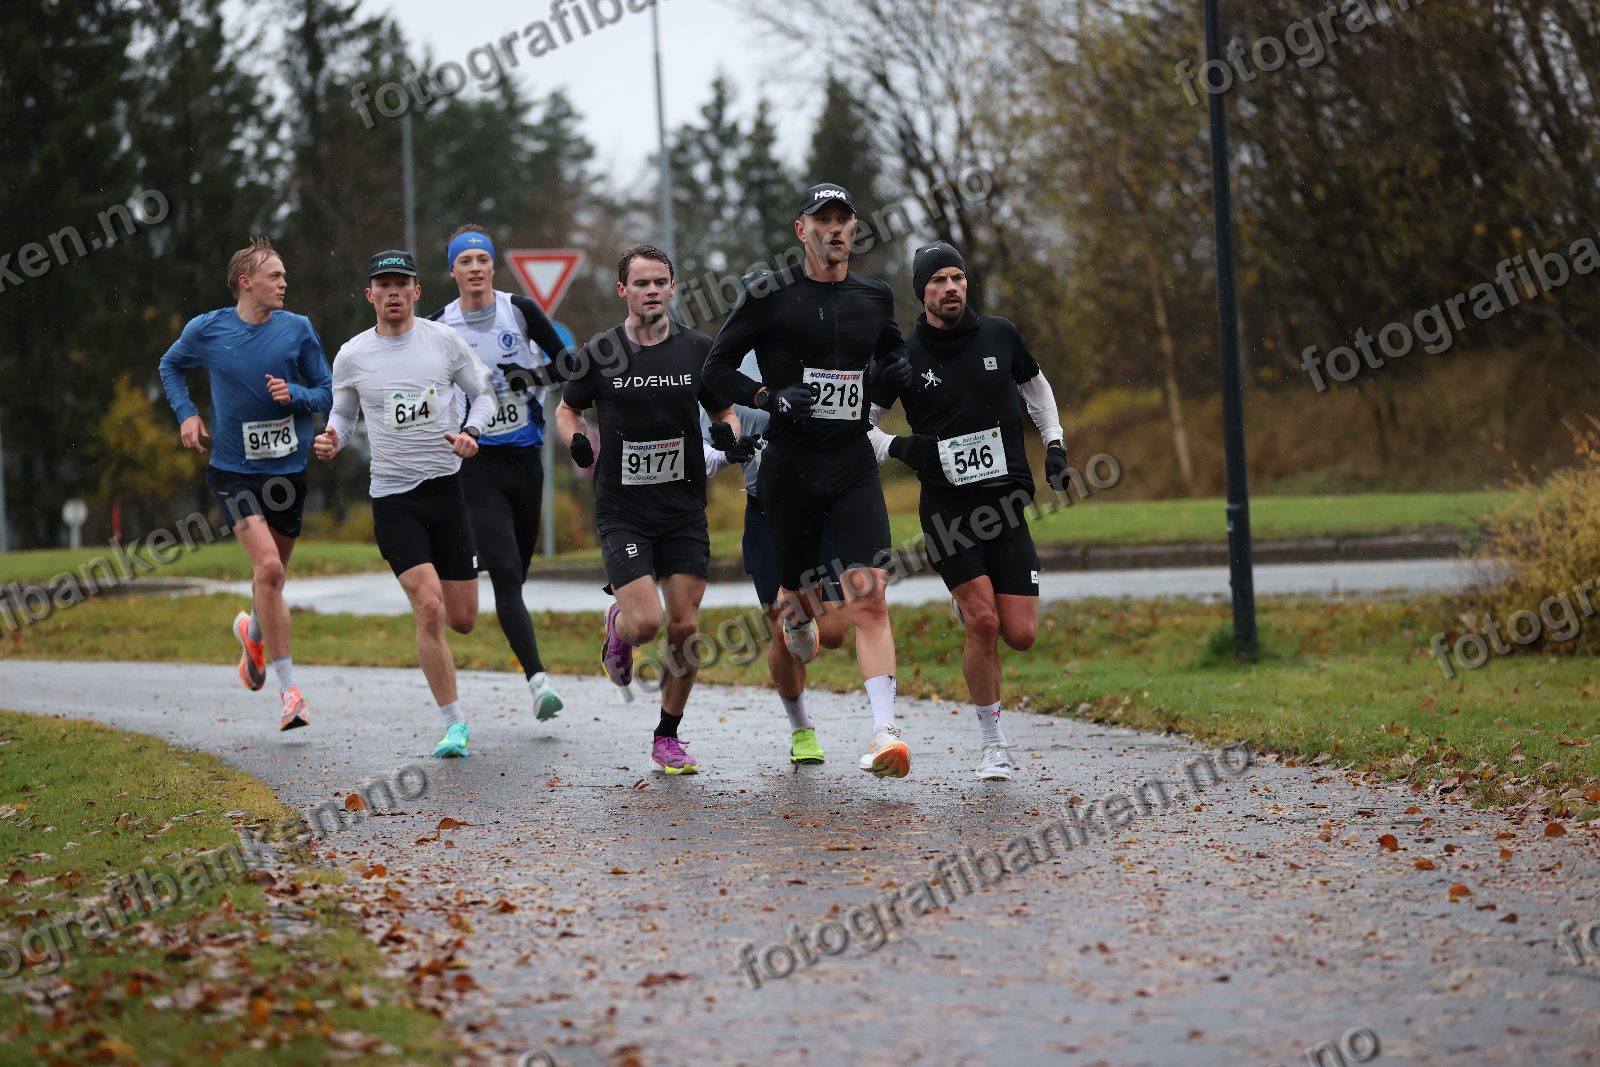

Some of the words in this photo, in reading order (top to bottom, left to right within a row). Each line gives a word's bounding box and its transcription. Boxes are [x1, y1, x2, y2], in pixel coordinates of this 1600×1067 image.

[814, 190, 846, 200] HOKA
[379, 258, 405, 267] HOKA
[809, 371, 861, 380] NORGESTESTEN
[809, 382, 859, 407] 9218
[396, 401, 430, 424] 614
[249, 426, 291, 450] 9478
[628, 441, 680, 451] NORGESTESTEN
[628, 449, 679, 474] 9177
[954, 445, 993, 474] 546
